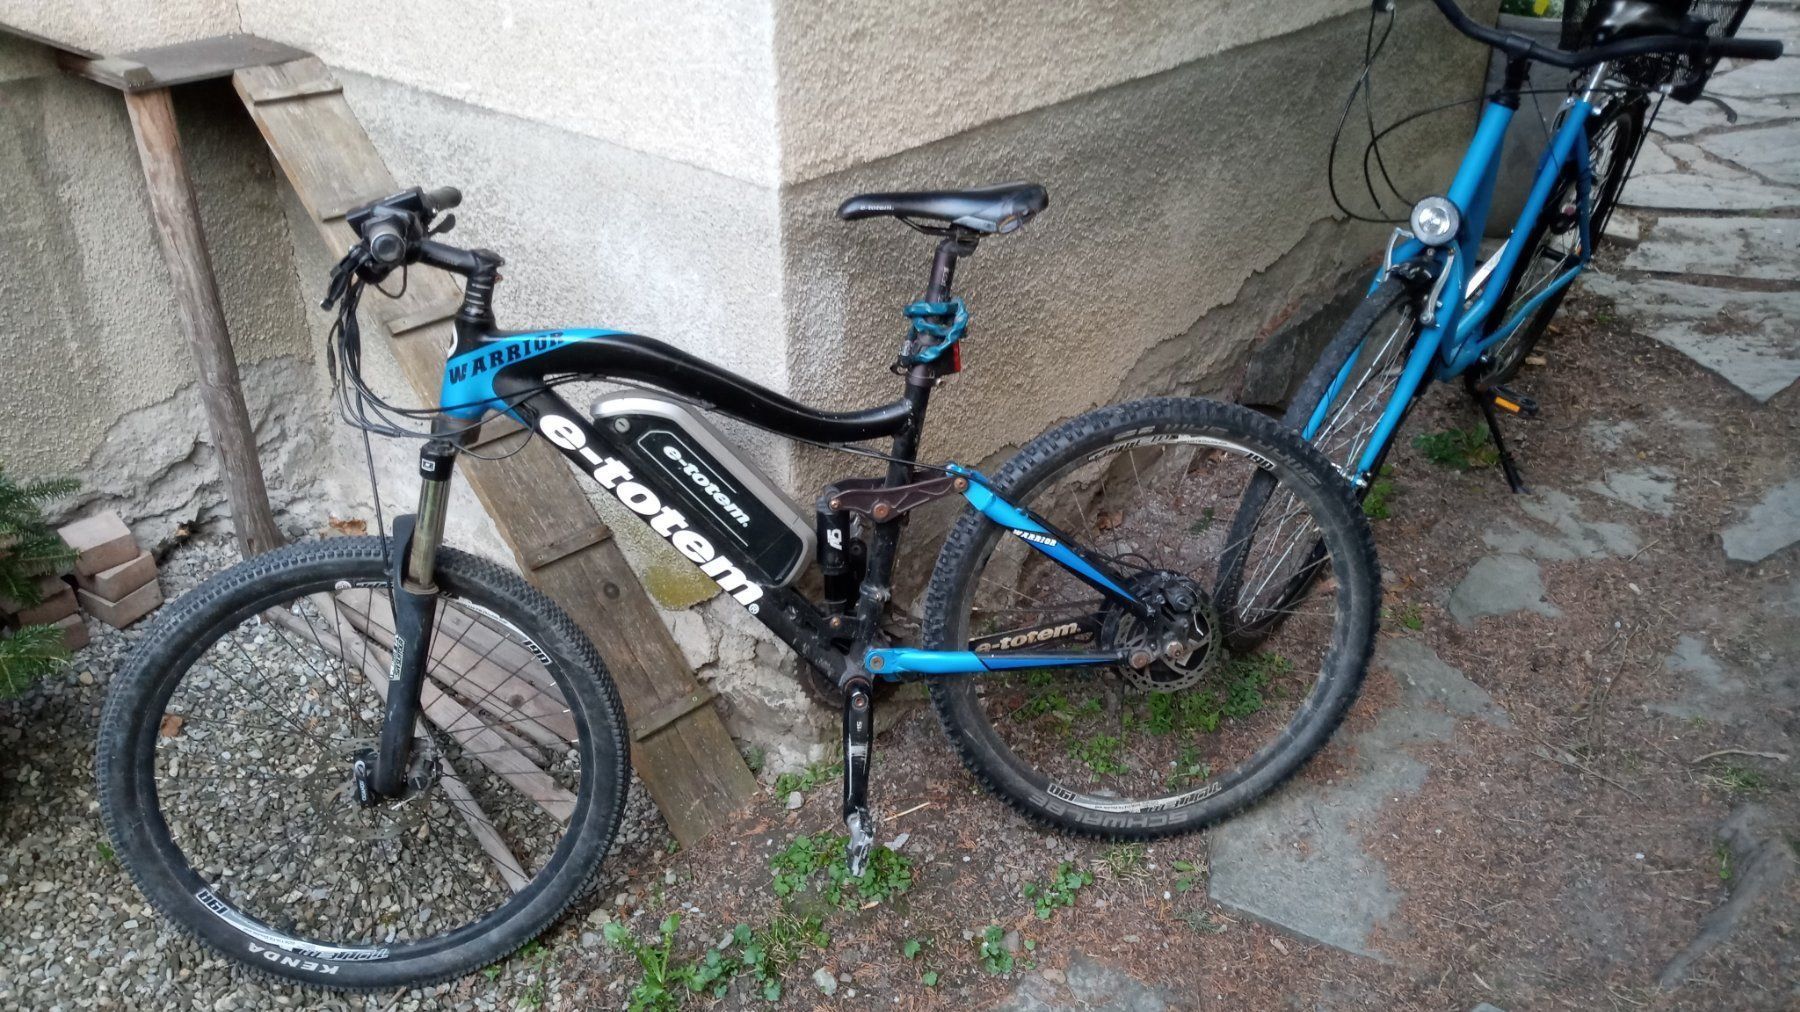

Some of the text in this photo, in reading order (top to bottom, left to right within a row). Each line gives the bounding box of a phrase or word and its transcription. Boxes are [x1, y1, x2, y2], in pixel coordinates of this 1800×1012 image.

[449, 331, 564, 384] WARRIOR
[1012, 528, 1057, 546] WARRIOR
[1028, 793, 1188, 829] SCHWALBE
[248, 942, 340, 975] KENDA
